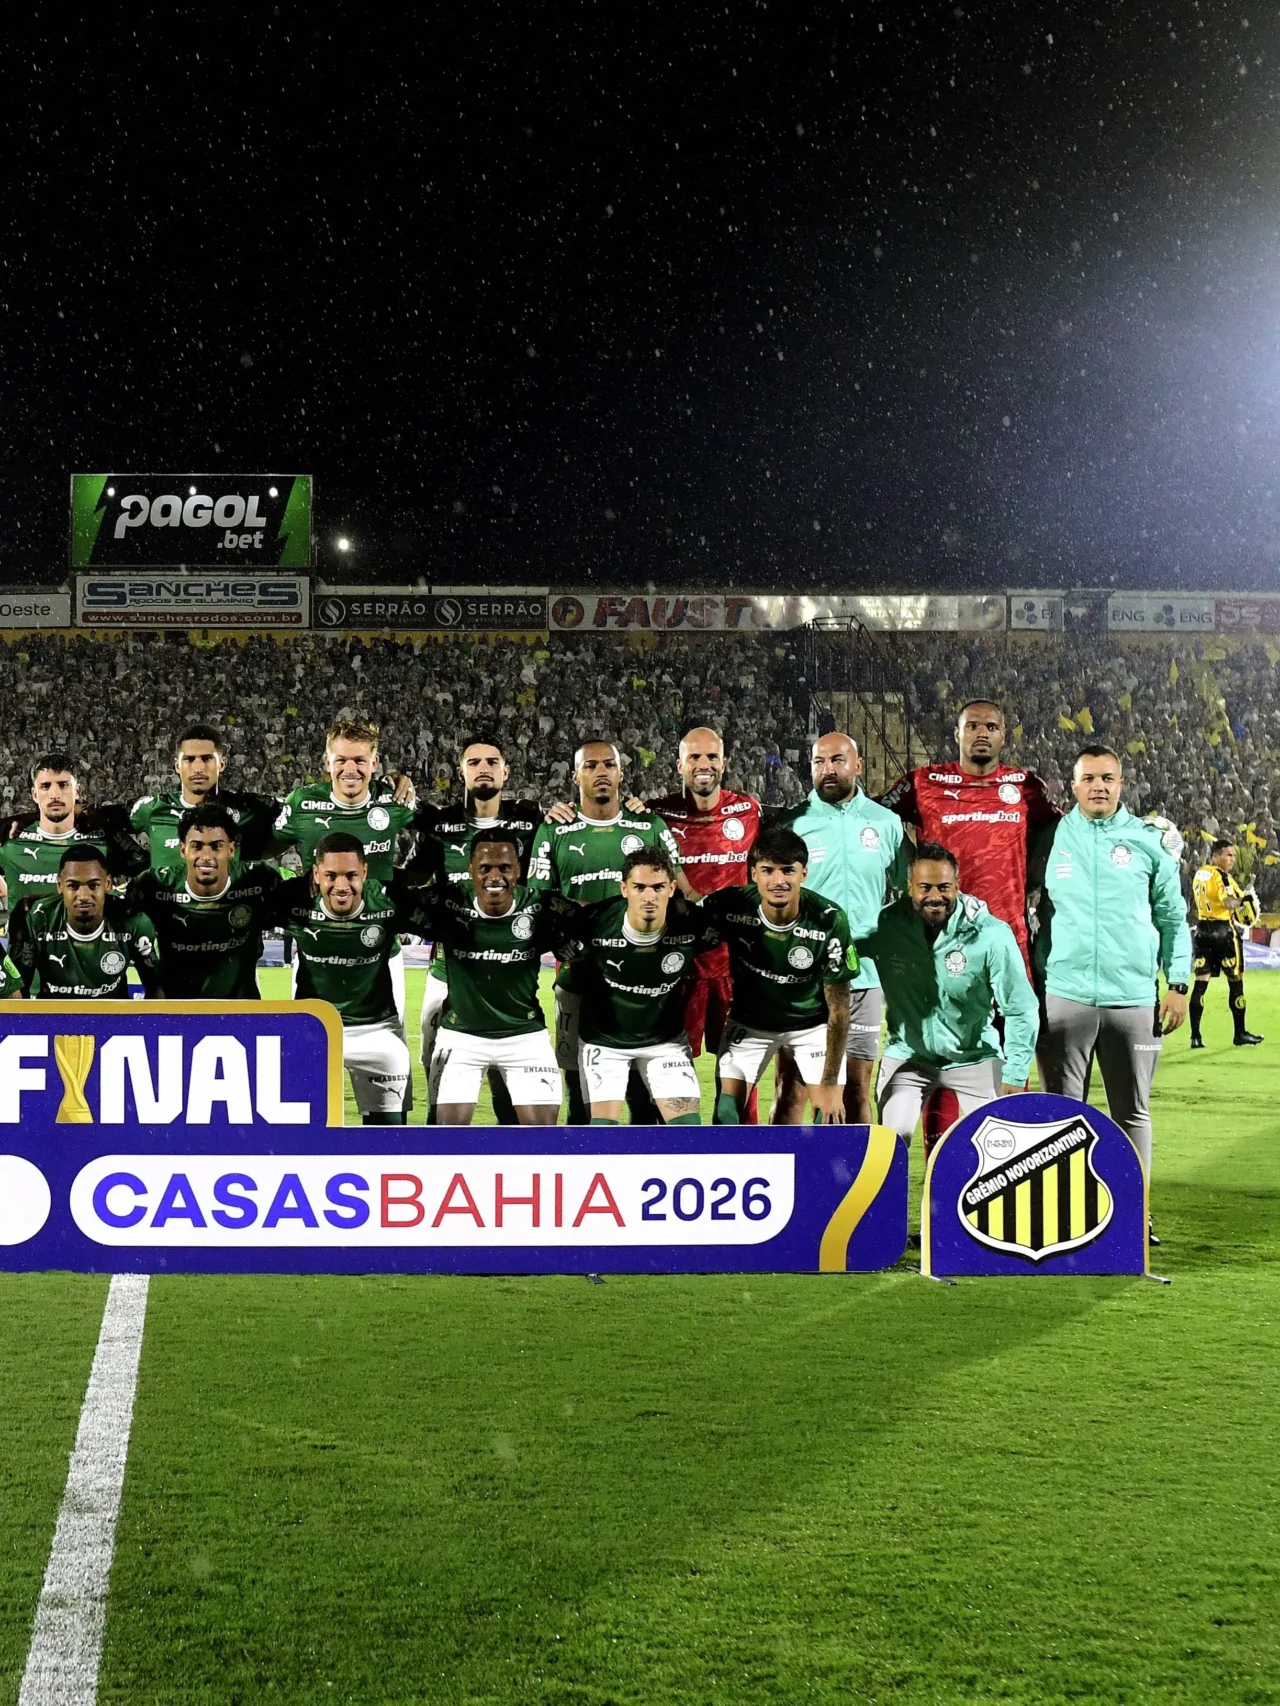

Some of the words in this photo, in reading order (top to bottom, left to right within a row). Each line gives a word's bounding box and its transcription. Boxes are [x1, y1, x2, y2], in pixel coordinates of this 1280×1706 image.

[0, 603, 52, 618] Oeste
[351, 599, 426, 616] SERRÃO
[467, 599, 543, 616] SERRÃO
[87, 612, 299, 624] www.sanchesrodos.com.br
[928, 772, 963, 784] CIMED
[301, 800, 336, 811] CIMED
[655, 806, 688, 819] CIMED
[720, 800, 752, 816] CIMED
[940, 810, 1021, 824] sportingbet
[435, 822, 467, 833] CIMED
[555, 822, 587, 835] CIMED
[618, 819, 652, 831] CIMED
[18, 830, 44, 842] IMED
[679, 850, 749, 866] portingbet
[18, 871, 58, 886] sporti
[570, 868, 624, 886] sporting
[155, 890, 192, 904] CIMED
[226, 885, 263, 900] CIMED
[291, 906, 326, 922] CIMED
[359, 908, 396, 921] CIMED
[445, 898, 479, 919] CIMED
[725, 912, 762, 927] CIMED
[661, 934, 696, 946] CIMED
[792, 926, 827, 941] CIMED
[591, 937, 628, 948] CIMED
[453, 948, 535, 964] sportingbet
[436, 1048, 453, 1066] 11
[586, 1047, 601, 1068] 12
[965, 1174, 1008, 1206] GRÊMIO
[1006, 1126, 1088, 1183] NOVORIZONTINO
[640, 1176, 772, 1222] 2026
